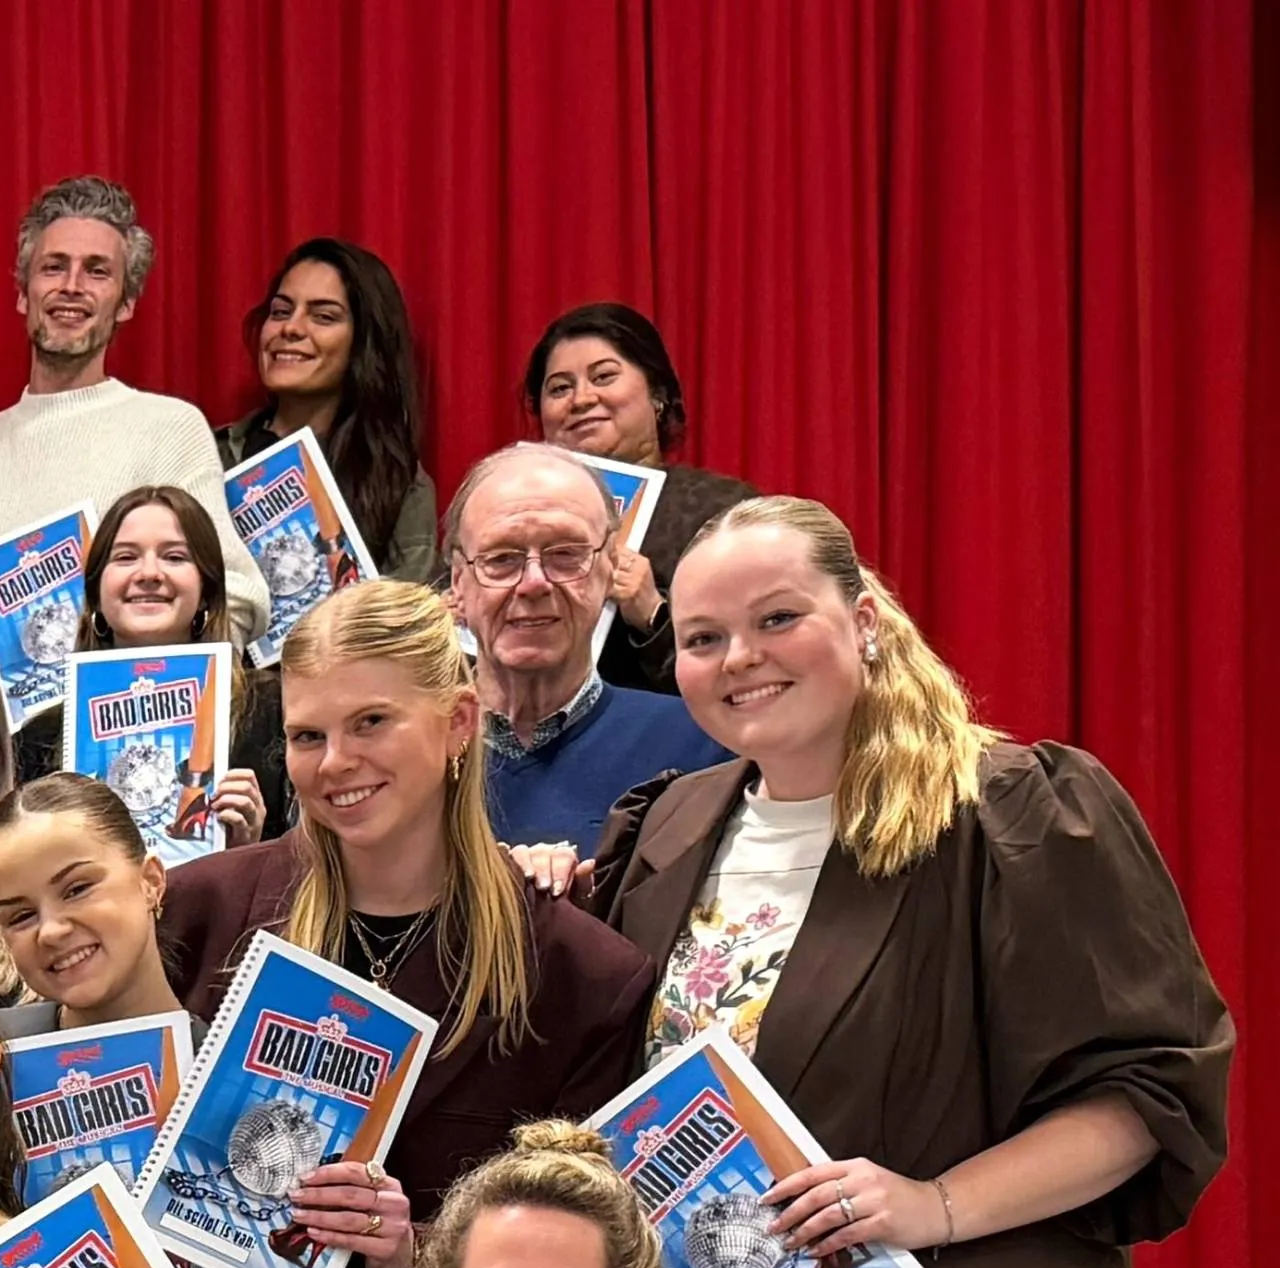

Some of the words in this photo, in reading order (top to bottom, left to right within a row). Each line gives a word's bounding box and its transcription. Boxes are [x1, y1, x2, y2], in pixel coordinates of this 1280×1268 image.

[234, 508, 262, 537] AD
[259, 476, 304, 521] GIRLS
[31, 546, 77, 588] GIRLS
[99, 698, 139, 732] BAD
[140, 687, 193, 726] GIRLS
[258, 1022, 315, 1075] BAD
[312, 1038, 380, 1097] GIRLS
[16, 1099, 74, 1148] BAD
[73, 1076, 150, 1133] GIRLS
[656, 1103, 735, 1180] GIRLS
[166, 1198, 184, 1217] Dit
[184, 1208, 221, 1234] script
[220, 1222, 233, 1239] is
